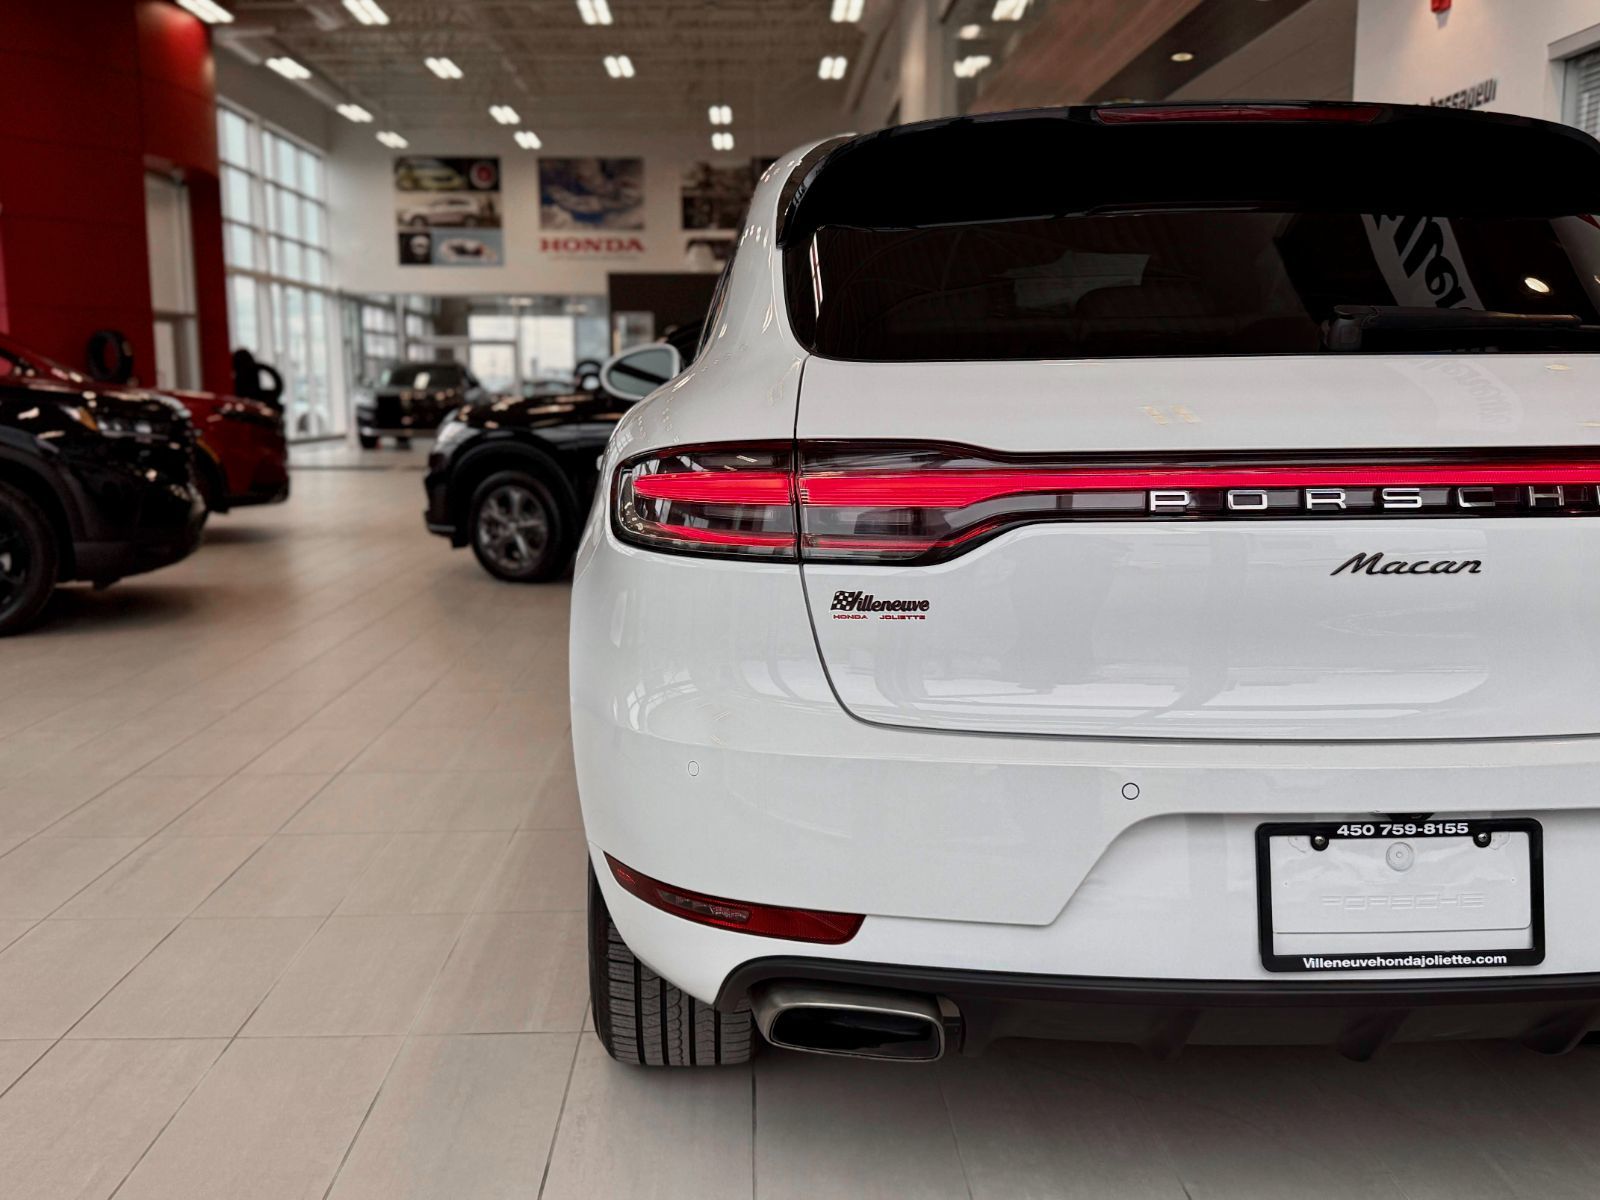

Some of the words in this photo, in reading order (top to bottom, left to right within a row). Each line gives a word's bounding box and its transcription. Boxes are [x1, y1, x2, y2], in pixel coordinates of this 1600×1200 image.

[539, 236, 645, 254] HONDA
[1330, 552, 1482, 576] Macan
[831, 590, 930, 612] Villeneuve
[1336, 824, 1375, 836] 450
[1380, 823, 1469, 835] 759-8155
[1302, 954, 1507, 969] Villeneuvehondajoliette.com
